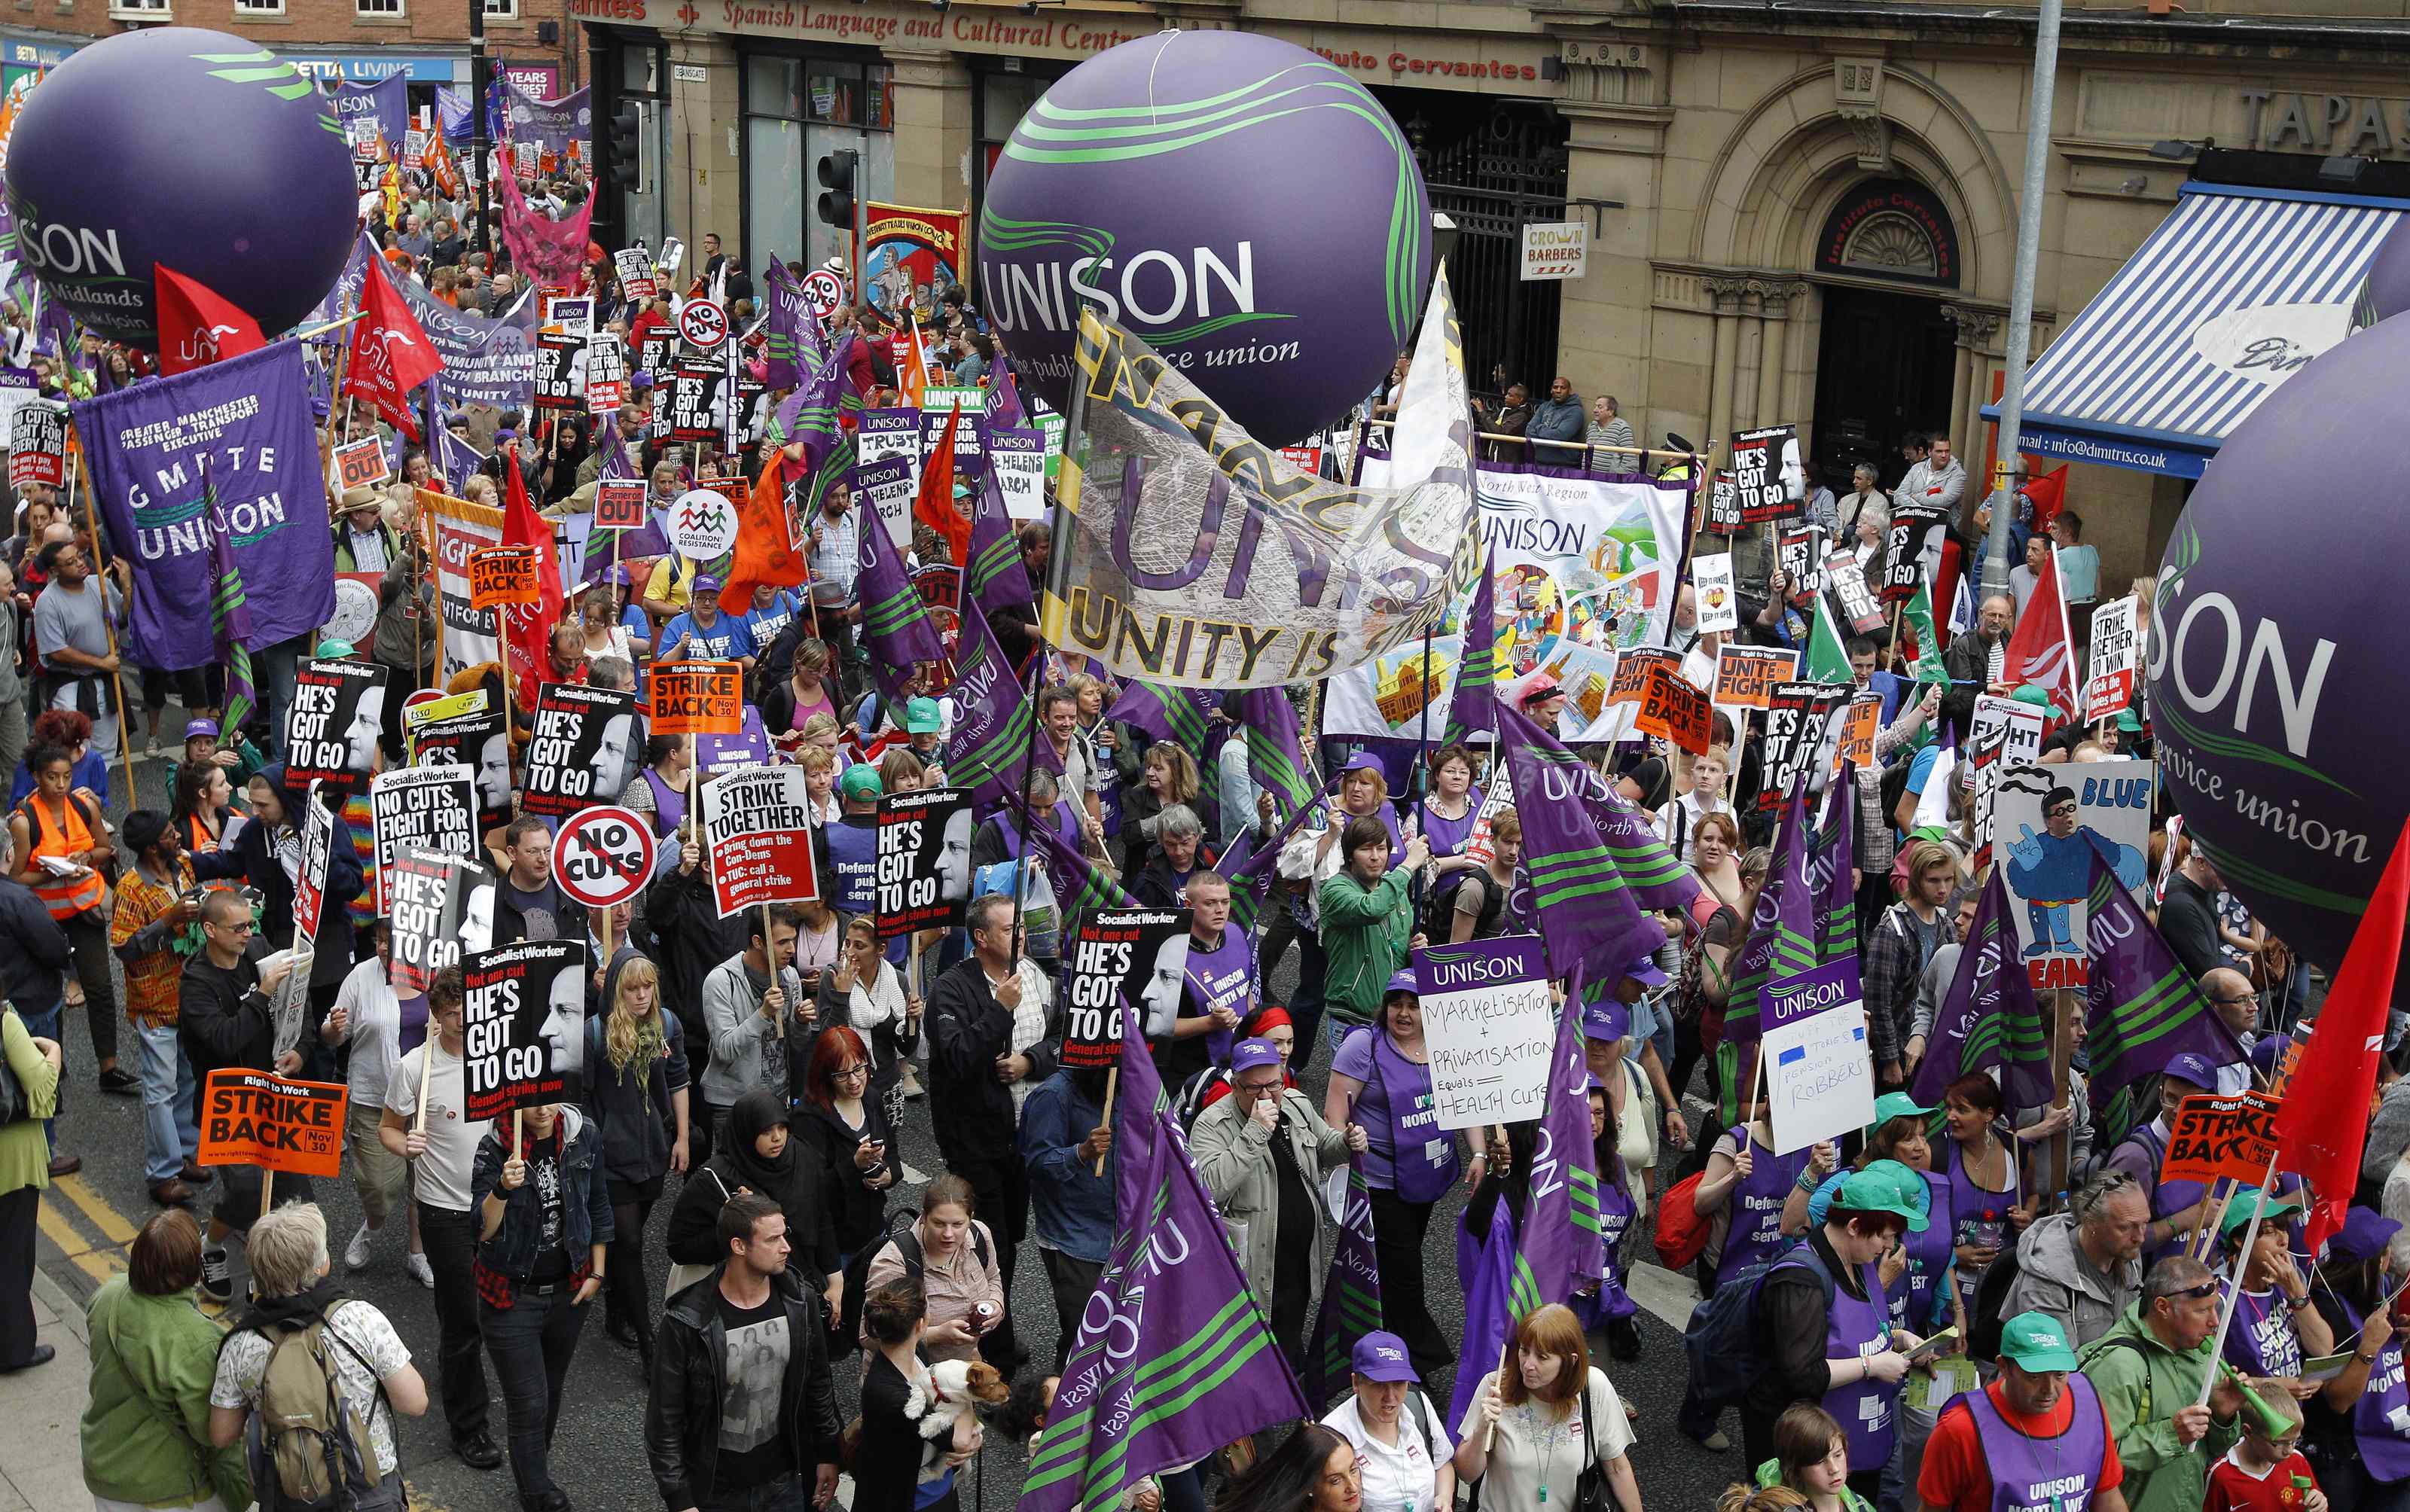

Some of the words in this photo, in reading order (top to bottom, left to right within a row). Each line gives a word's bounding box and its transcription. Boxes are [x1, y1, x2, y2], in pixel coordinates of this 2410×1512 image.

[723, 0, 794, 29] Spanish
[801, 5, 897, 39] Language
[905, 12, 944, 39] and
[953, 14, 1052, 47] Cultural
[354, 62, 413, 77] LIVING
[508, 72, 547, 83] YEARS
[1388, 53, 1536, 80] Cervantes
[1529, 248, 1581, 261] BARBERS
[982, 239, 1255, 331] UNISON
[503, 354, 535, 367] AND
[1205, 337, 1299, 367] union
[474, 369, 533, 383] BRANCH
[443, 383, 456, 395] IN
[462, 388, 511, 401] UNITY
[924, 390, 981, 407] UNISON
[120, 420, 170, 441] GREATER
[177, 395, 257, 425] MANCHESTER
[191, 403, 259, 434] TRANSPORT
[12, 437, 39, 456] EVERY
[42, 440, 61, 456] JOB
[41, 425, 61, 442] FOR
[162, 428, 222, 452] EXECUTIVE
[346, 455, 380, 482] OUT
[1002, 454, 1043, 473] HELENS
[603, 489, 641, 500] Cameron
[1477, 475, 1514, 493] North
[1518, 480, 1541, 494] West
[1547, 484, 1588, 501] Region
[601, 500, 642, 523] OUT
[679, 533, 721, 542] COALITION
[679, 539, 722, 550] RESISTANCE
[473, 558, 532, 579] STRIKE
[474, 575, 520, 596] BACK
[1066, 586, 1282, 678] UNITY
[1722, 658, 1777, 678] UNITE
[2106, 651, 2124, 674] WIN
[294, 684, 337, 713] HE'S
[655, 676, 734, 697] STRIKE
[2092, 678, 2106, 695] Kick
[2110, 676, 2120, 689] the
[2110, 688, 2123, 705] out
[656, 698, 717, 718] BACK
[717, 700, 734, 708] Nov
[720, 707, 731, 716] 30
[292, 712, 331, 739] GOT
[536, 710, 583, 742] HE'S
[290, 740, 311, 767] TO
[316, 741, 344, 770] GO
[532, 739, 575, 767] GOT
[717, 749, 751, 761] UNISON
[708, 762, 737, 773] NORTH
[560, 769, 590, 797] GO
[2080, 777, 2152, 809] BLUE
[378, 791, 401, 818] NO
[407, 785, 459, 809] CUTS,
[719, 783, 787, 814] STRIKE
[380, 809, 428, 841] FIGHT
[433, 807, 468, 829] FOR
[708, 806, 805, 843] TOGETHER
[2236, 788, 2372, 864] union
[440, 831, 471, 853] JOB
[578, 825, 627, 853] NO
[724, 840, 747, 855] Bring
[749, 836, 773, 848] down
[776, 834, 792, 845] the
[566, 849, 645, 883] CUTS
[726, 850, 771, 867] Con-Dems
[878, 851, 918, 885] GOT
[727, 867, 747, 883] TUC:
[749, 864, 766, 876] call
[769, 864, 774, 873] a
[729, 877, 762, 897] general
[764, 875, 792, 886] strike
[395, 870, 447, 909] HE'S
[877, 883, 902, 913] TO
[908, 876, 935, 908] GO
[393, 901, 441, 937] GOT
[1081, 927, 1100, 940] Not
[1103, 931, 1121, 940] one
[1124, 928, 1140, 940] cut
[427, 938, 460, 969] GO
[1075, 941, 1133, 974] HE'S
[466, 974, 485, 989] Not
[488, 969, 504, 982] one
[507, 963, 526, 977] cut
[1213, 968, 1246, 993] UNISON
[1433, 955, 1524, 986] UNISON
[467, 979, 520, 1023] HE'S
[1774, 980, 1845, 1020] UNISON
[467, 1014, 515, 1058] GOT
[1069, 1007, 1103, 1041] TO
[1064, 1041, 1103, 1055] General
[468, 1054, 500, 1093] TO
[505, 1045, 542, 1081] GO
[244, 1076, 270, 1089] Right
[271, 1084, 280, 1093] to
[282, 1085, 310, 1096] Work
[468, 1089, 505, 1109] General
[506, 1080, 537, 1097] strike
[541, 1079, 563, 1092] now
[1790, 1057, 1866, 1109] ROBBERS
[212, 1090, 333, 1127] STRIKE
[1440, 1090, 1505, 1118] HEALTH
[2211, 1101, 2235, 1111] Right
[209, 1117, 303, 1153] BACK
[308, 1132, 331, 1142] Nov
[312, 1142, 326, 1152] 30
[2029, 1474, 2085, 1501] UNISON
